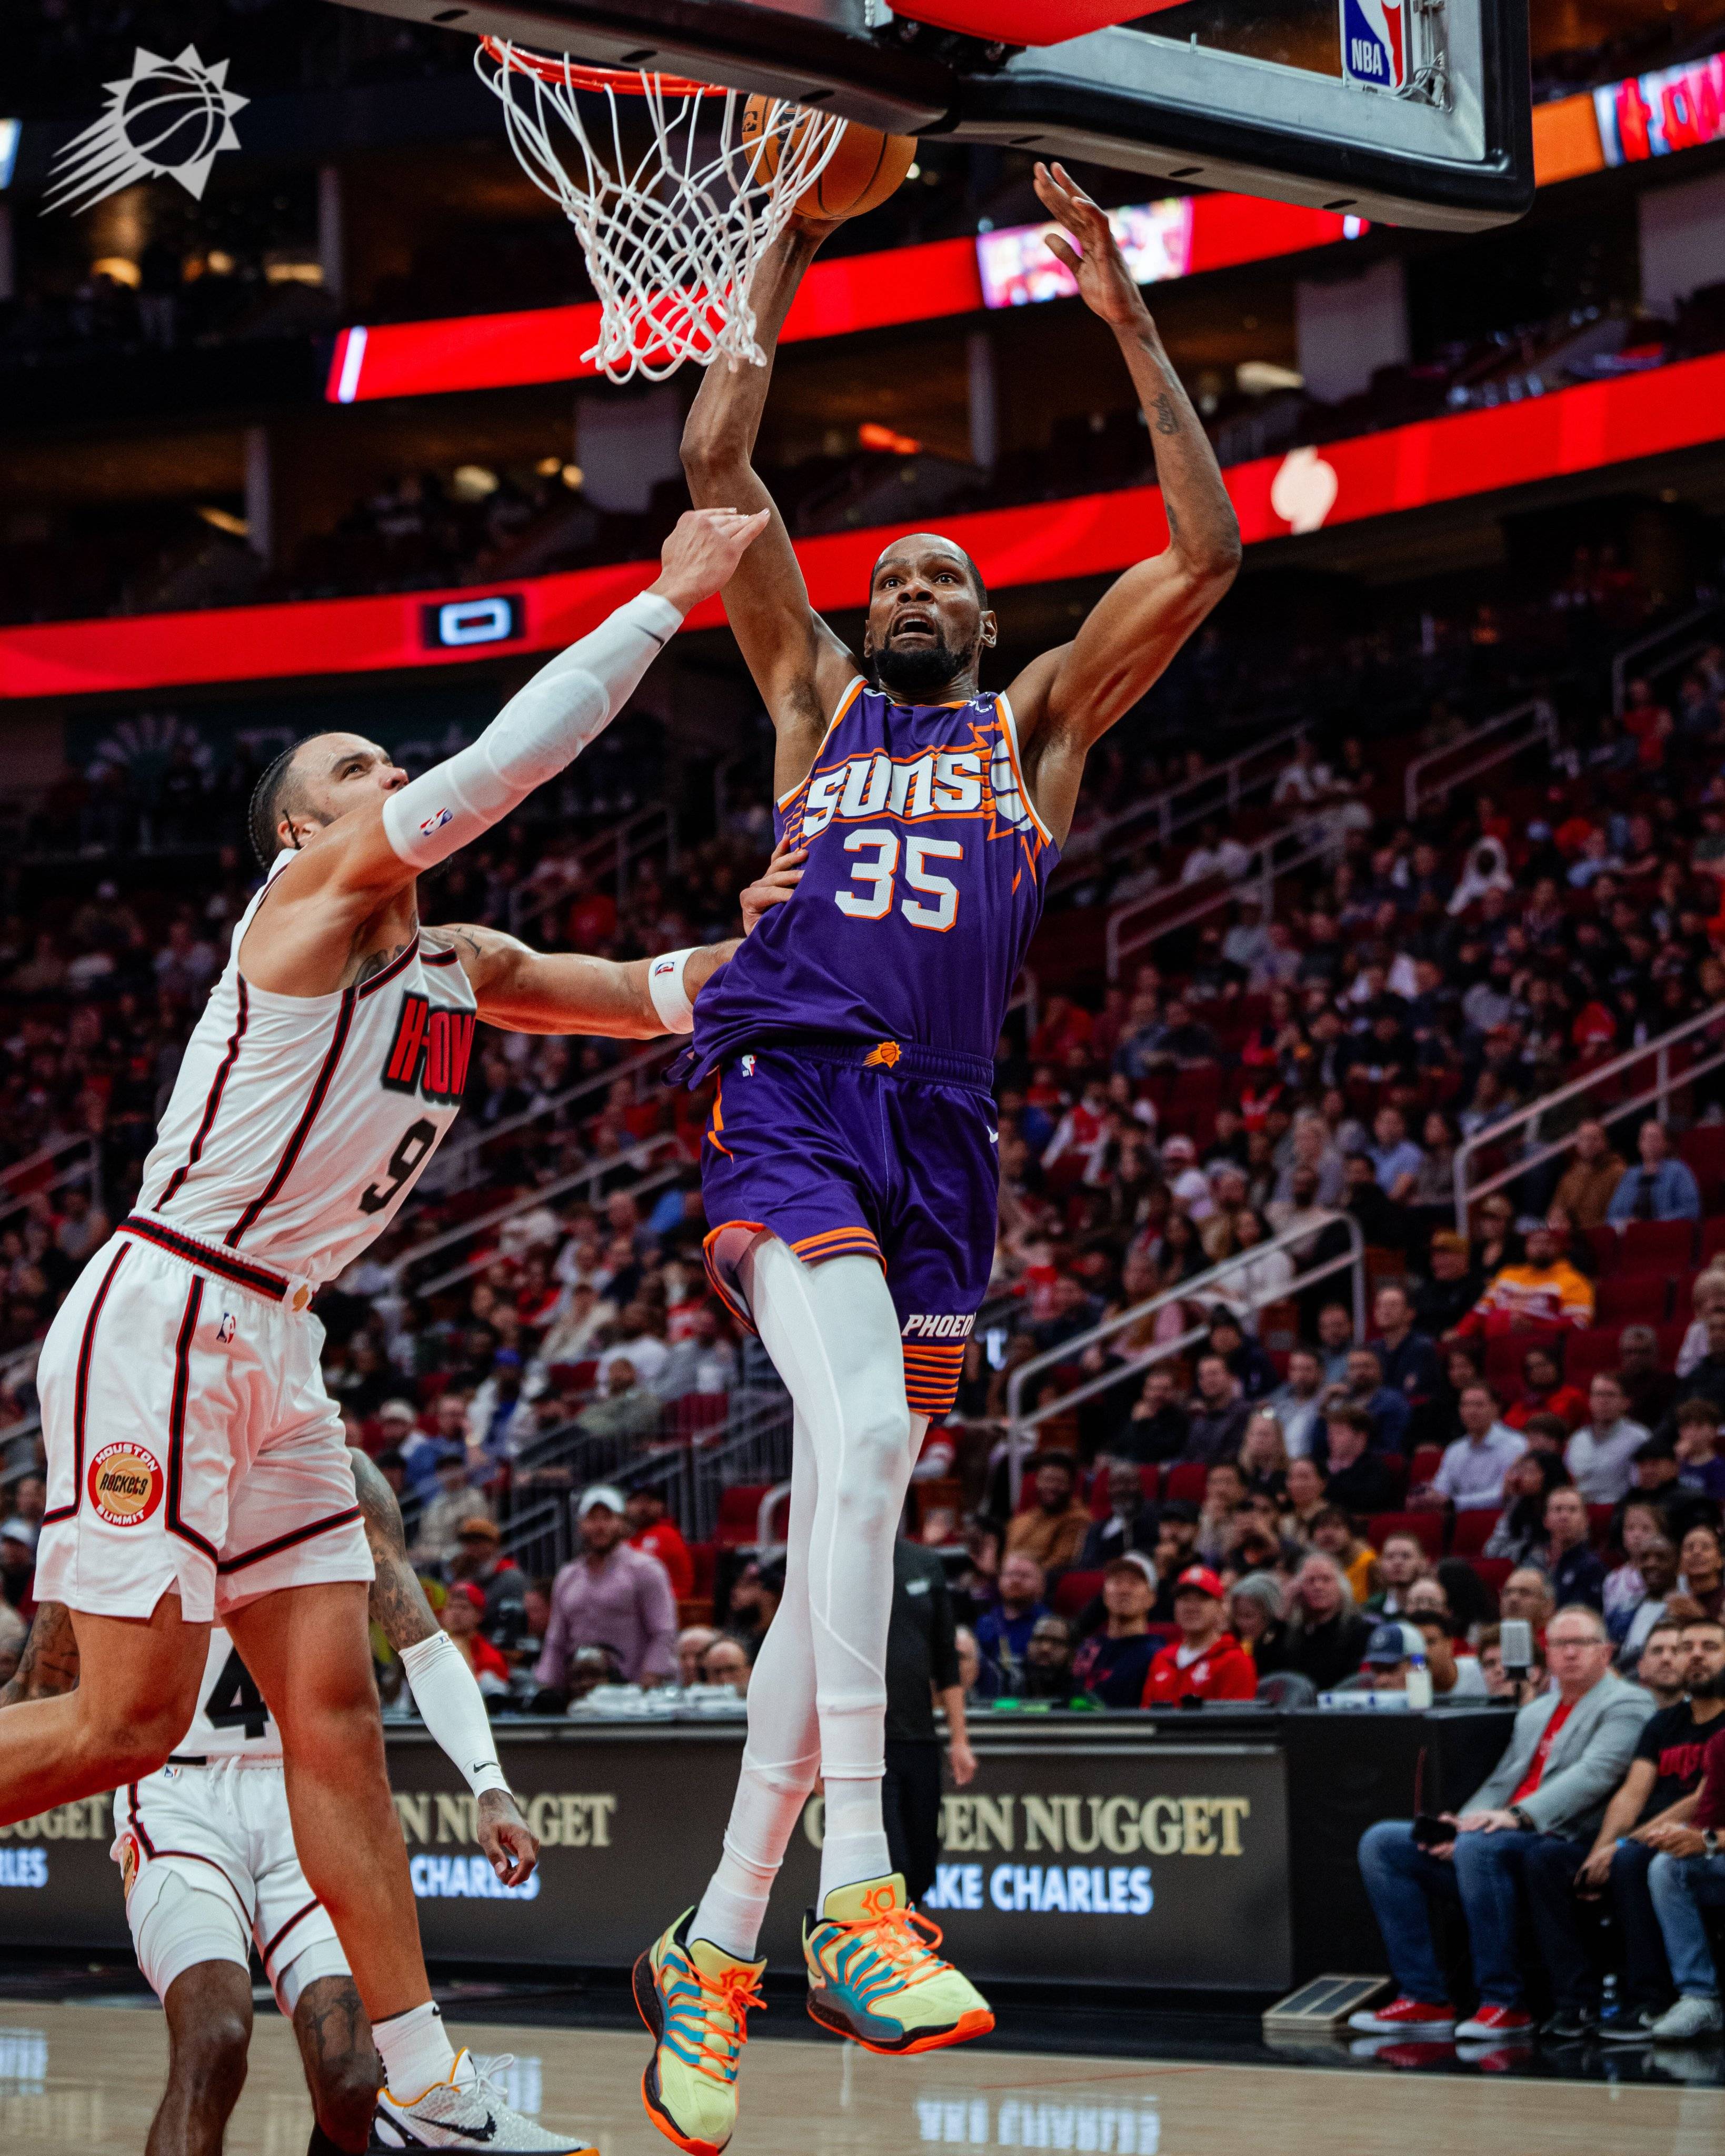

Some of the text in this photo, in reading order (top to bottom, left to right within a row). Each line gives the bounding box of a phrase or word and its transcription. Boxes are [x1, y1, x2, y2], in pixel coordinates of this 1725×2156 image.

[1351, 37, 1383, 76] NBA
[834, 829, 963, 932] 35
[357, 1117, 437, 1216] 9
[901, 1312, 976, 1338] PHOEN
[95, 1443, 158, 1472] HOUSTON
[96, 1503, 145, 1525] SUMMIT
[204, 1645, 271, 1740] 4
[1021, 1794, 1251, 1855] NUGGET
[990, 1863, 1154, 1915] CHARLES
